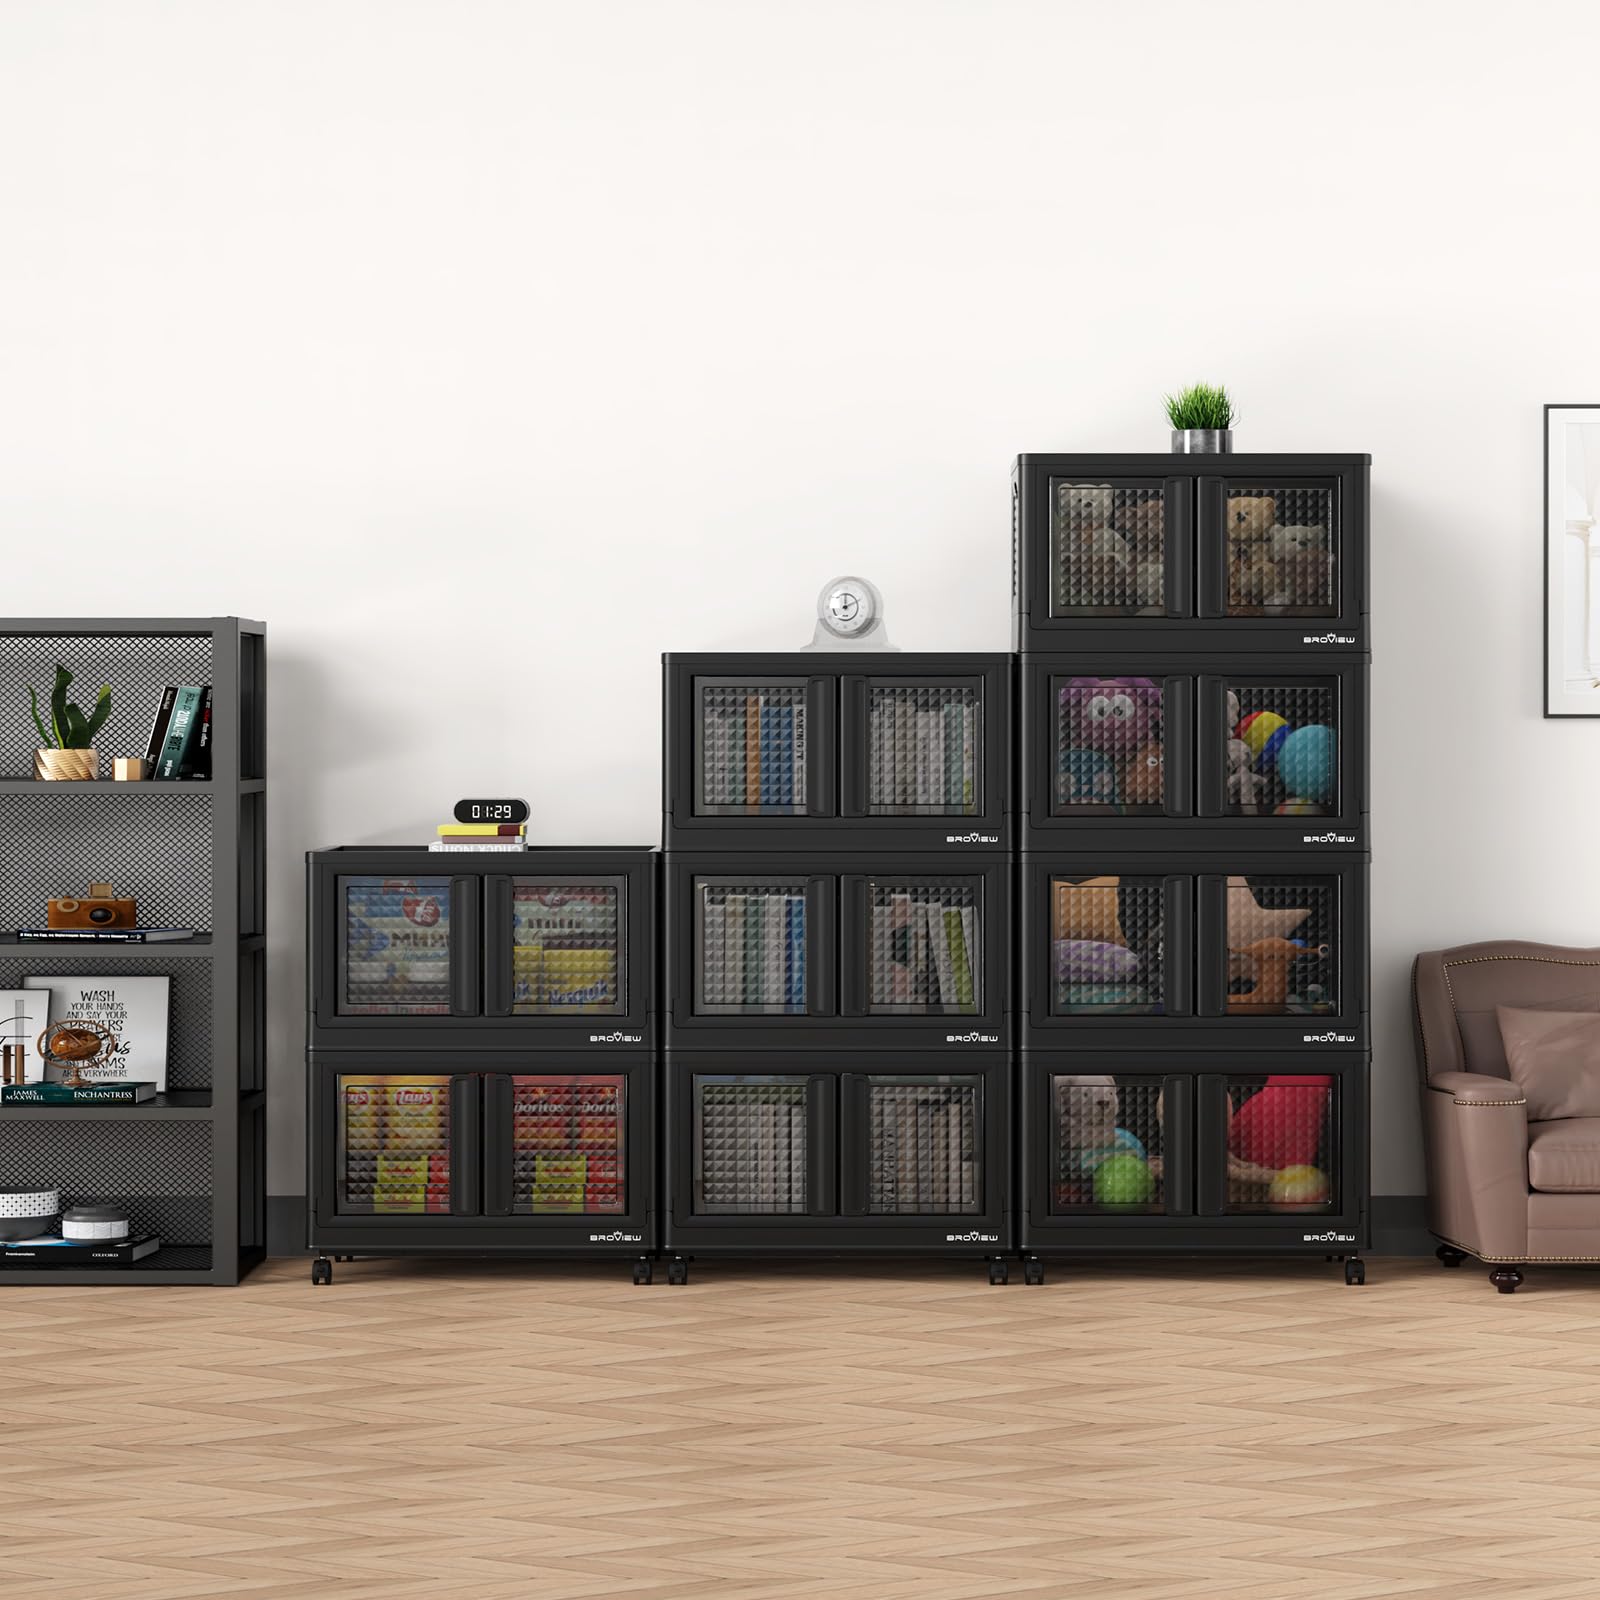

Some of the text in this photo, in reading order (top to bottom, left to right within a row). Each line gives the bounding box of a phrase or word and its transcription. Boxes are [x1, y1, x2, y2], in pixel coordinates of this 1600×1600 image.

[1304, 632, 1356, 643] BROVIEW
[796, 708, 805, 749] MAKING
[472, 805, 511, 818] 01:29
[947, 832, 999, 843] BROVIEW
[1304, 832, 1356, 843] BROVIEW
[81, 990, 115, 1002] WASH
[71, 1002, 124, 1011] YOUR HANDS
[66, 1011, 128, 1019] AND SAY YOUR
[590, 1031, 642, 1042] BROVIEW
[947, 1031, 999, 1042] BROVIEW
[1304, 1031, 1356, 1042] BROVIEW
[590, 1230, 642, 1241] BROVIEW
[947, 1230, 999, 1241] BROVIEW
[1304, 1230, 1356, 1241] BROVIEW
